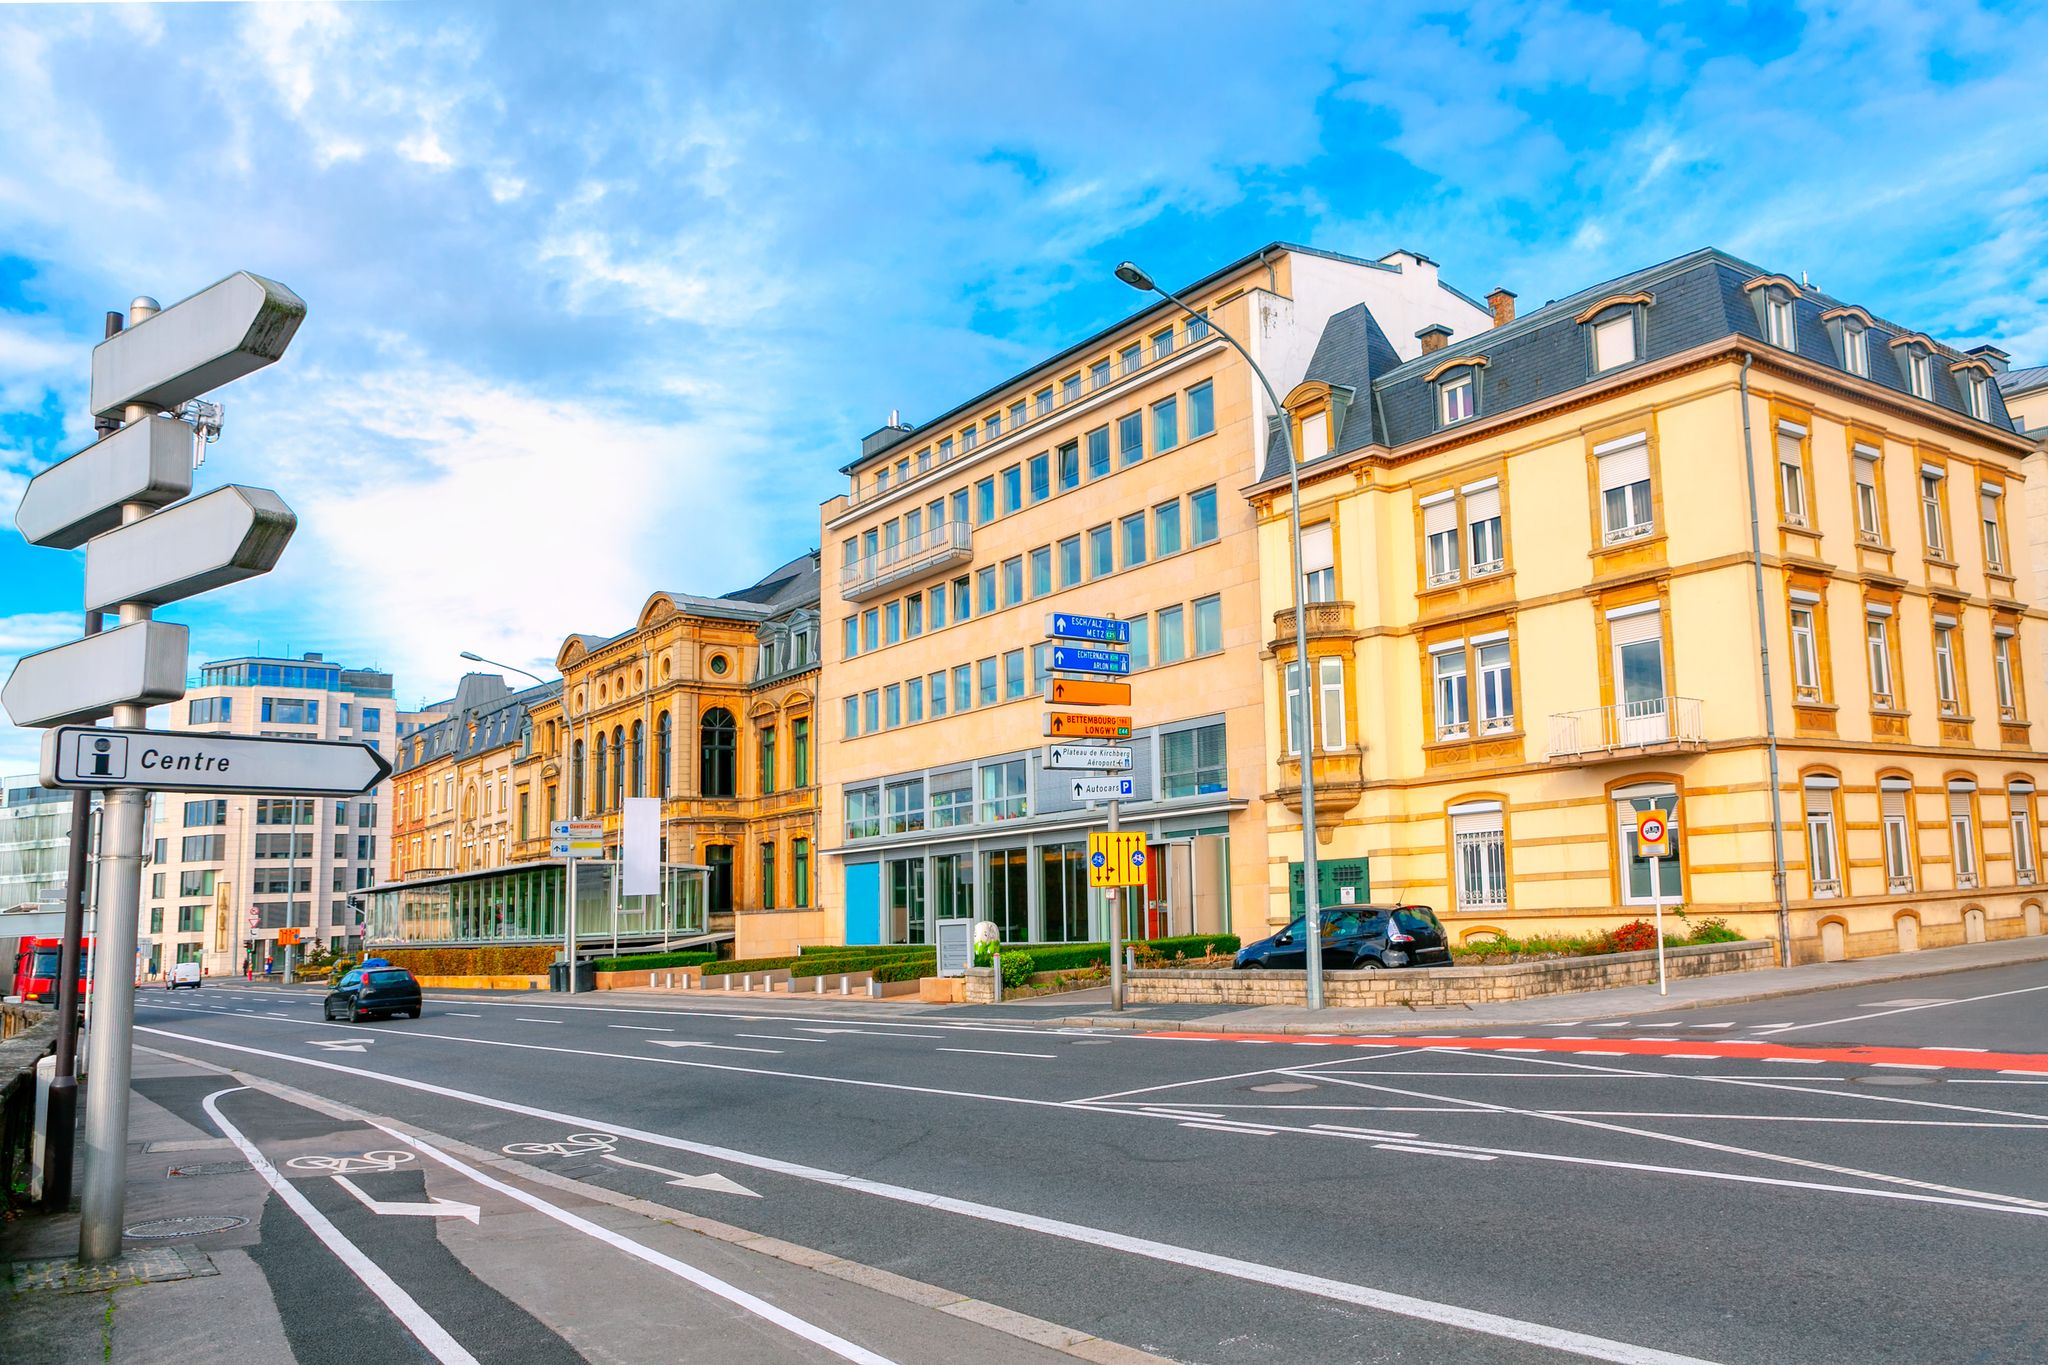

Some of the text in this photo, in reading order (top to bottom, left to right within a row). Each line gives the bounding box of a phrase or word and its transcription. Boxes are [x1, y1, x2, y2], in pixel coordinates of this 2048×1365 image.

[1072, 617, 1105, 628] ESCH/ALZ.
[1086, 629, 1105, 638] METZ
[1077, 651, 1109, 661] ECHTERNACH
[1093, 662, 1109, 670] ARLON
[1066, 715, 1116, 725] BETTEMBOURG
[1085, 727, 1116, 735] LONGWY
[1062, 748, 1088, 756] Plateau
[1100, 750, 1130, 759] Kirchberg
[141, 749, 230, 772] Centre
[1087, 759, 1116, 767] Aéroport
[1086, 781, 1129, 793] Autocars P
